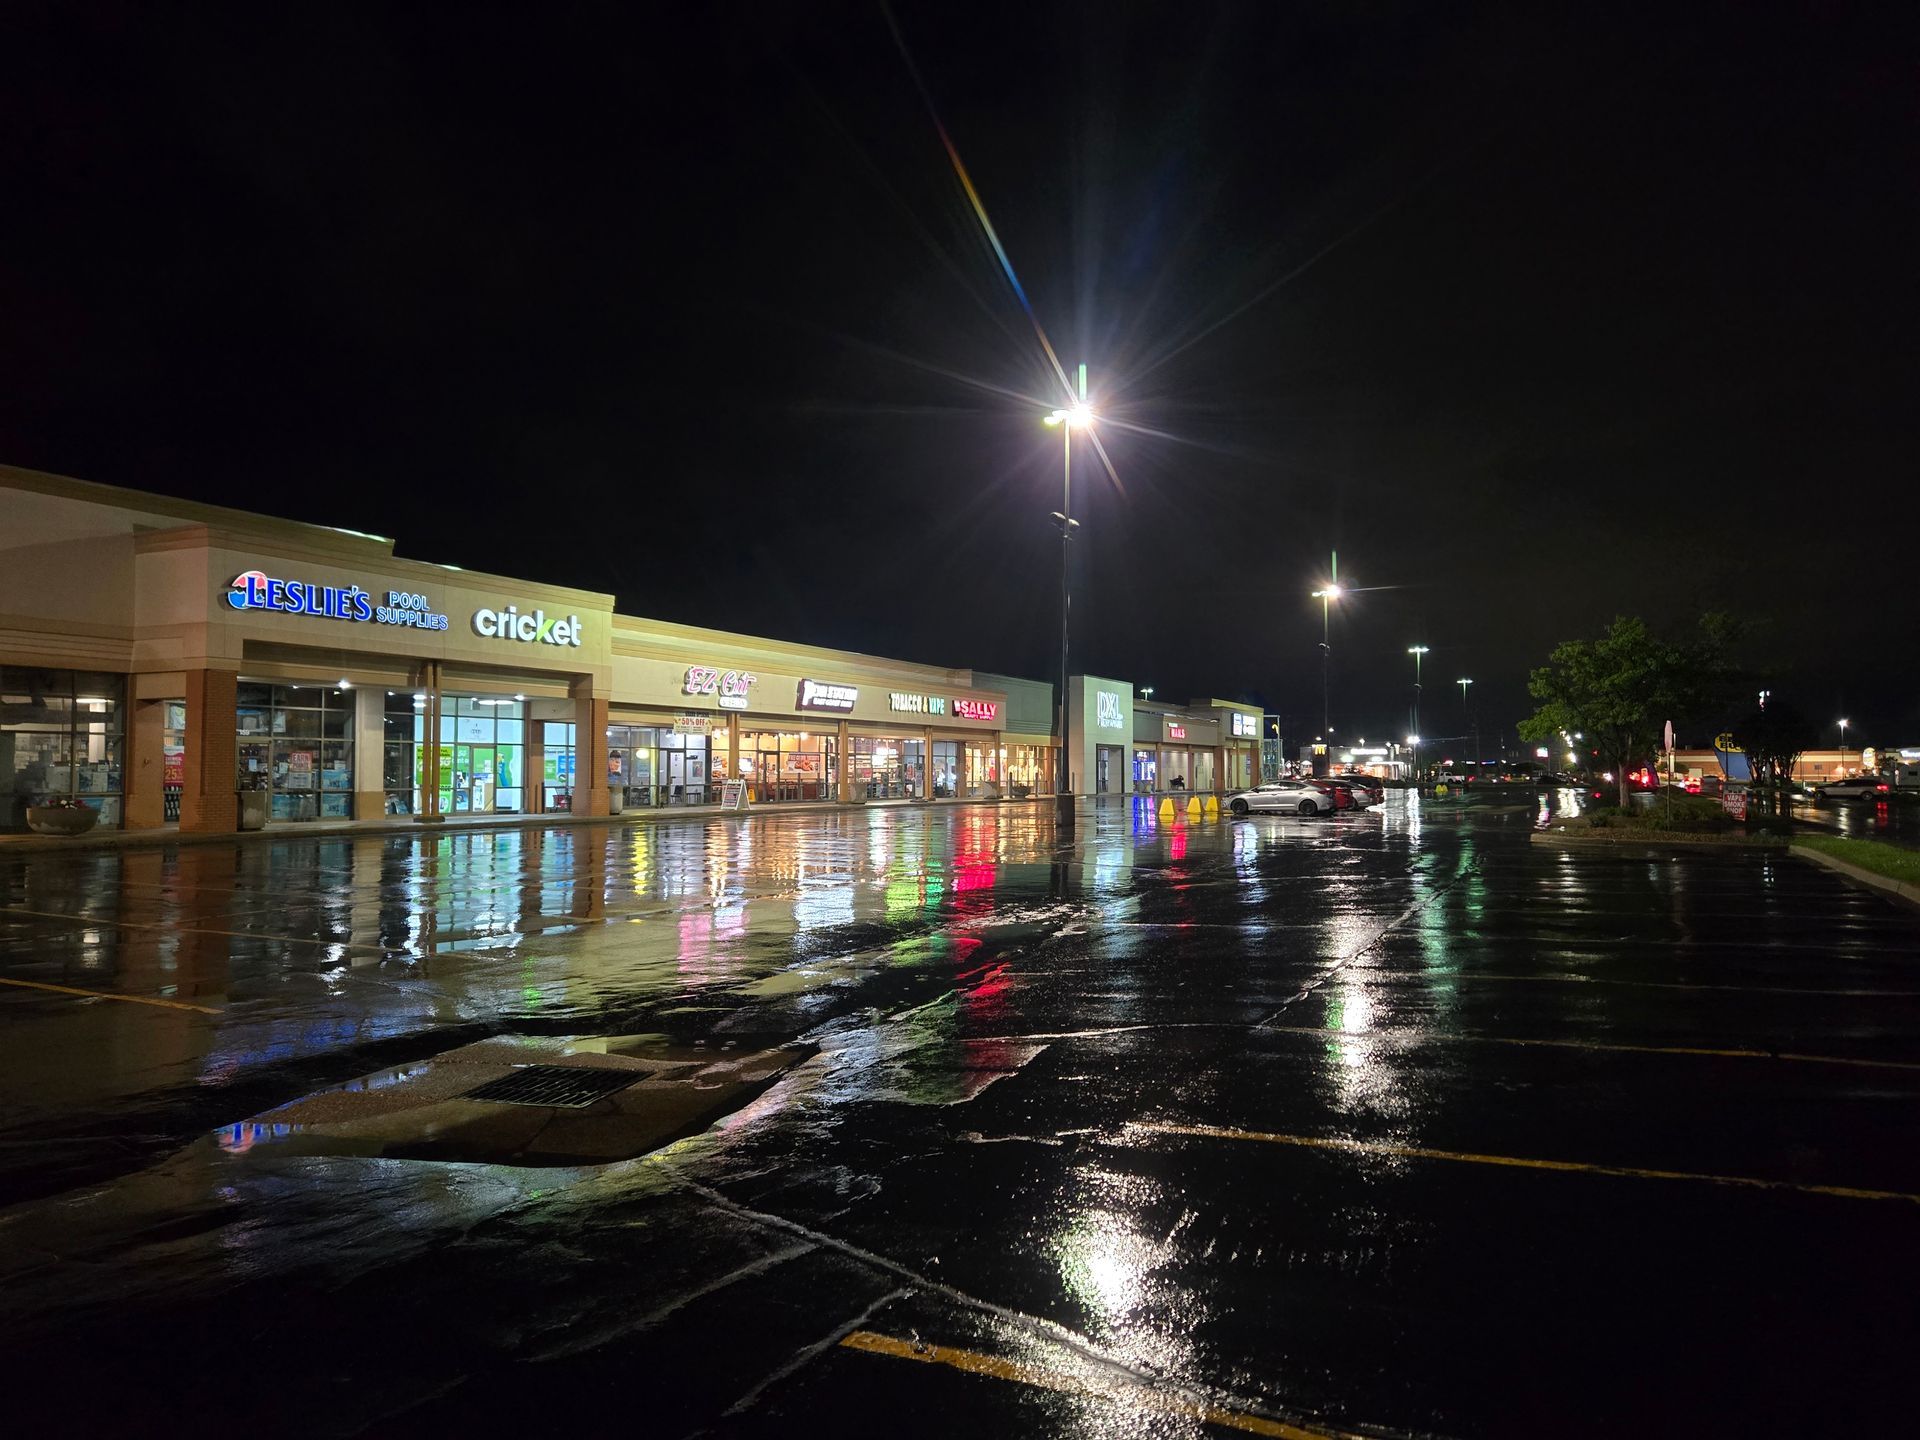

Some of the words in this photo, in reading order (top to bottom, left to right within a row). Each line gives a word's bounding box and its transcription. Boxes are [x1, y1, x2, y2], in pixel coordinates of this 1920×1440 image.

[246, 576, 372, 621] LESLIE'S
[390, 591, 430, 611] POOL
[376, 607, 449, 630] SUPPLIES
[476, 605, 582, 646] cricket
[686, 666, 718, 694] EZ
[721, 670, 757, 697] Cut
[890, 692, 923, 713] TOBACCO
[923, 696, 928, 713] &
[928, 697, 945, 715] VAPE
[961, 700, 997, 716] SALLY
[695, 718, 705, 726] OFF
